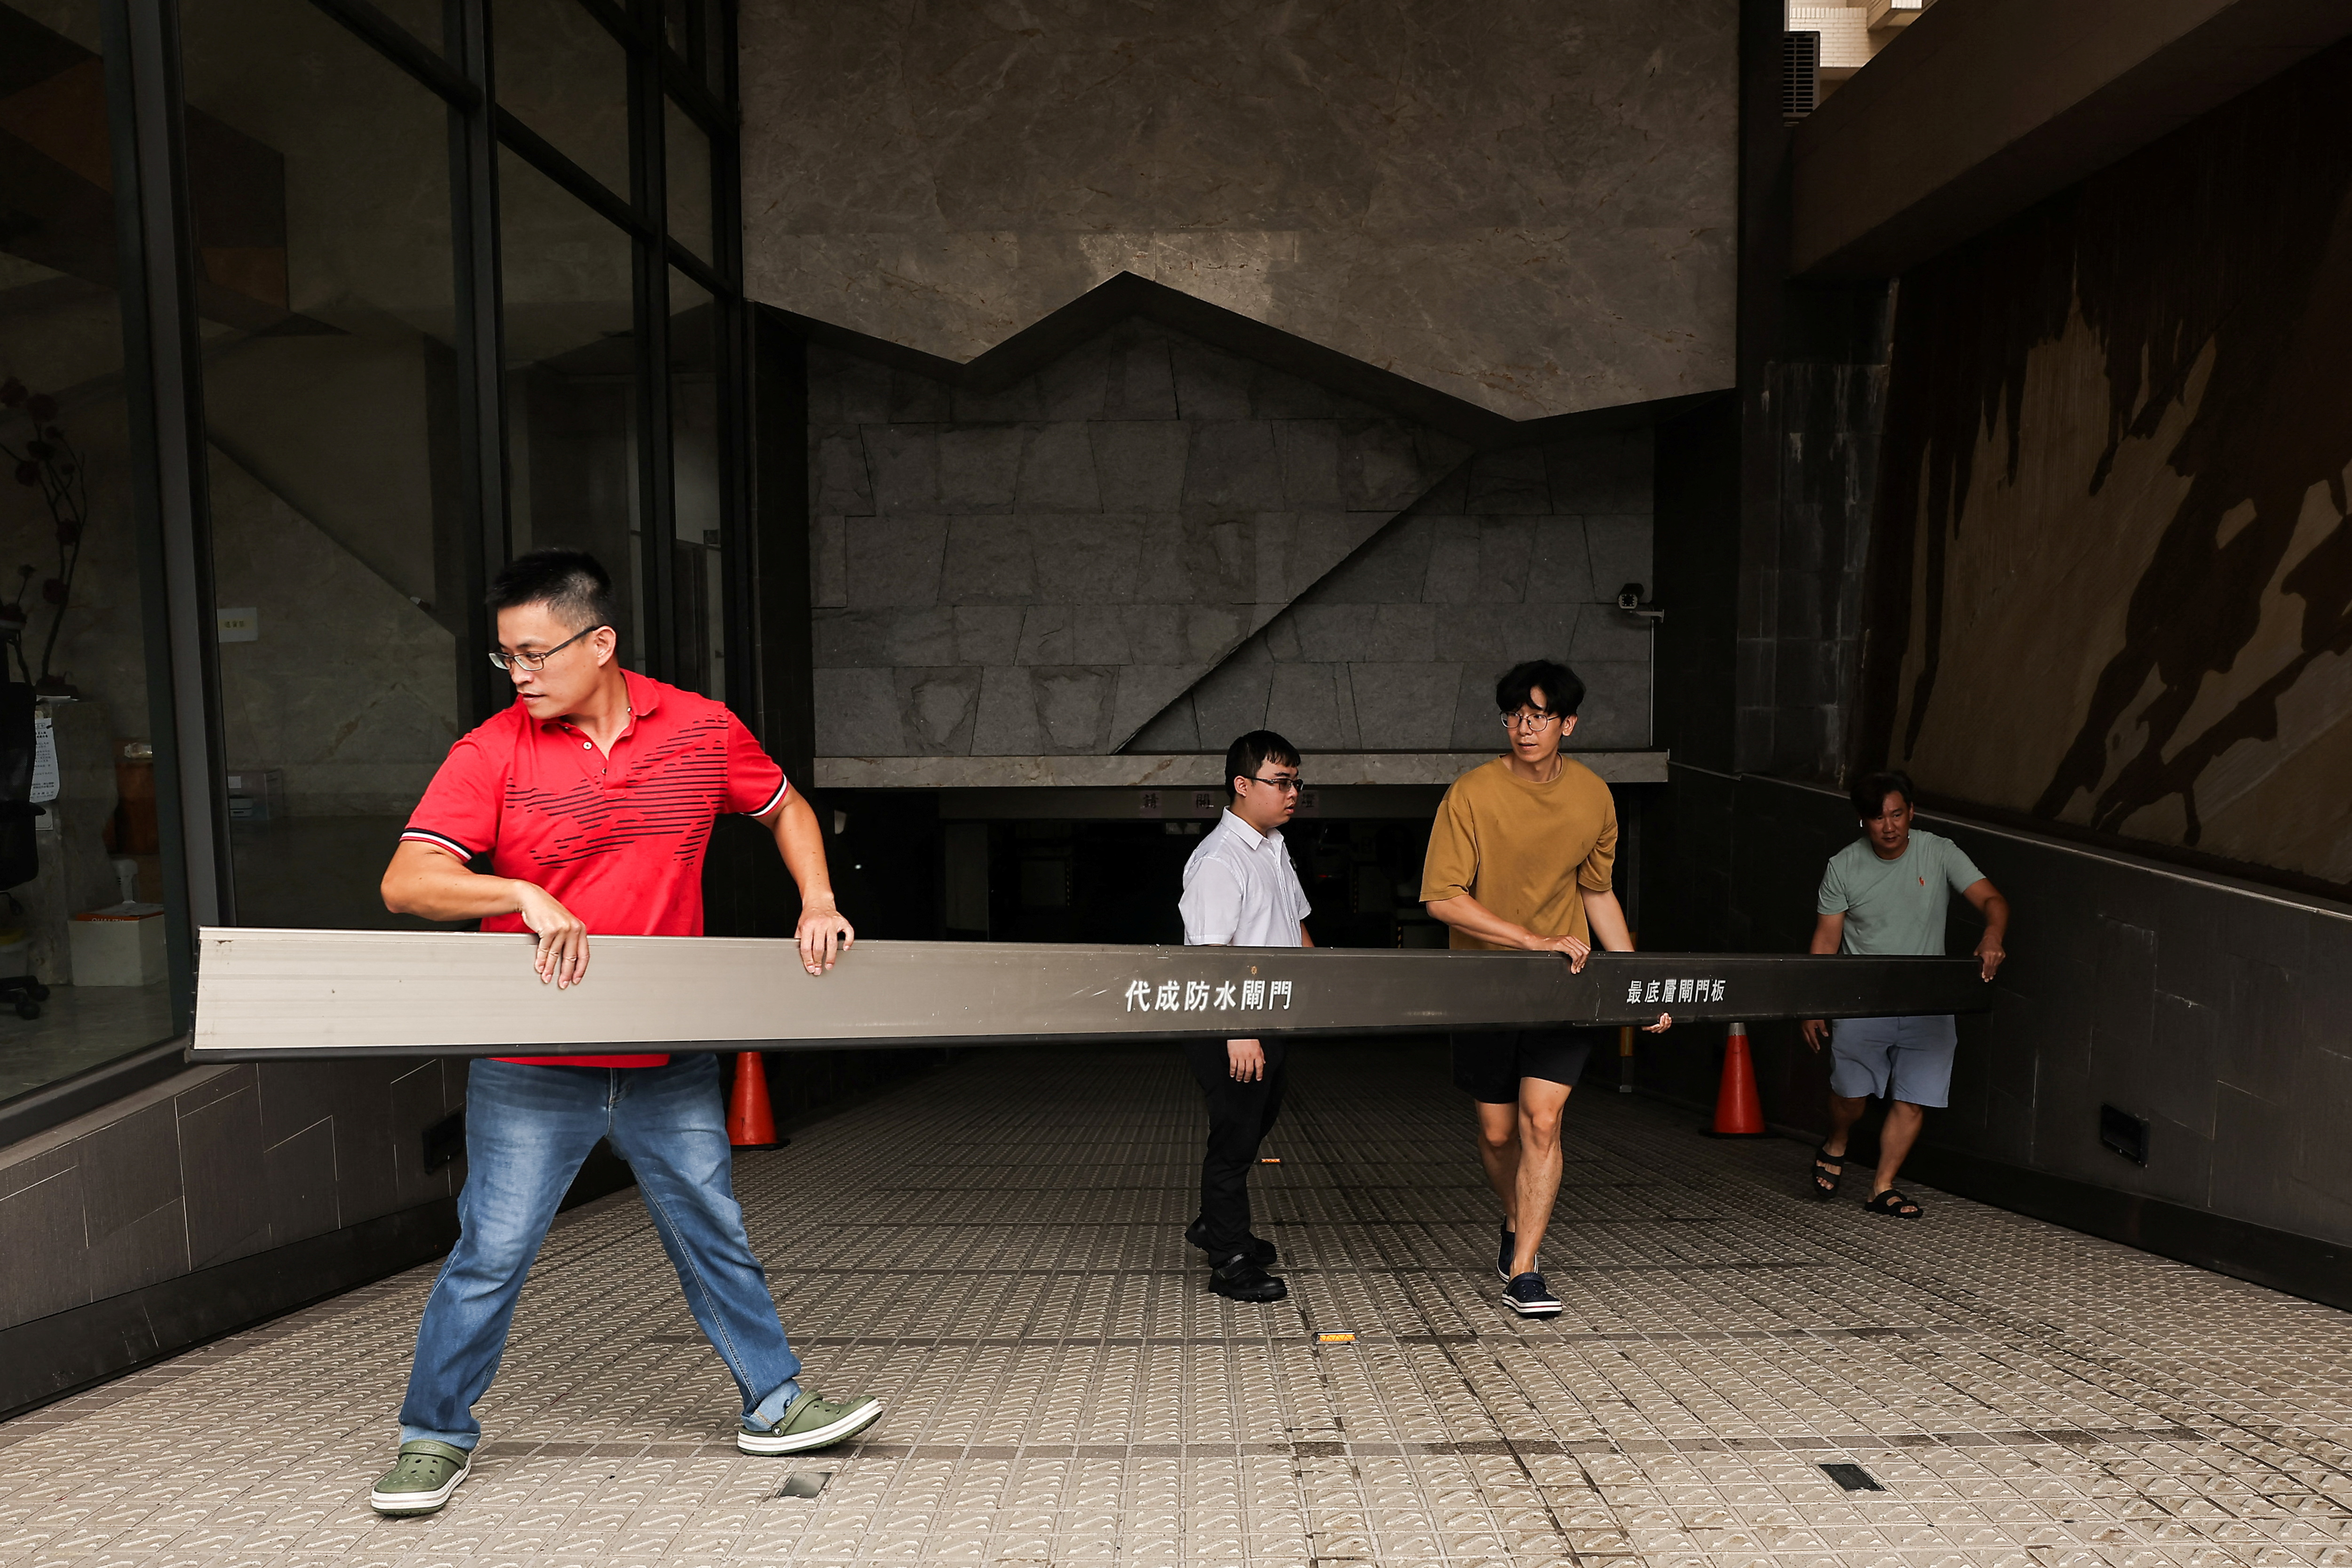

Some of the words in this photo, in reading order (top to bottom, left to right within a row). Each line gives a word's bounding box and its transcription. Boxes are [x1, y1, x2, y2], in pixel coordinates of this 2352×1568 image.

[1125, 979, 1292, 1012] 代成防水閘門
[1626, 979, 1726, 1004] 最底層閘門板
